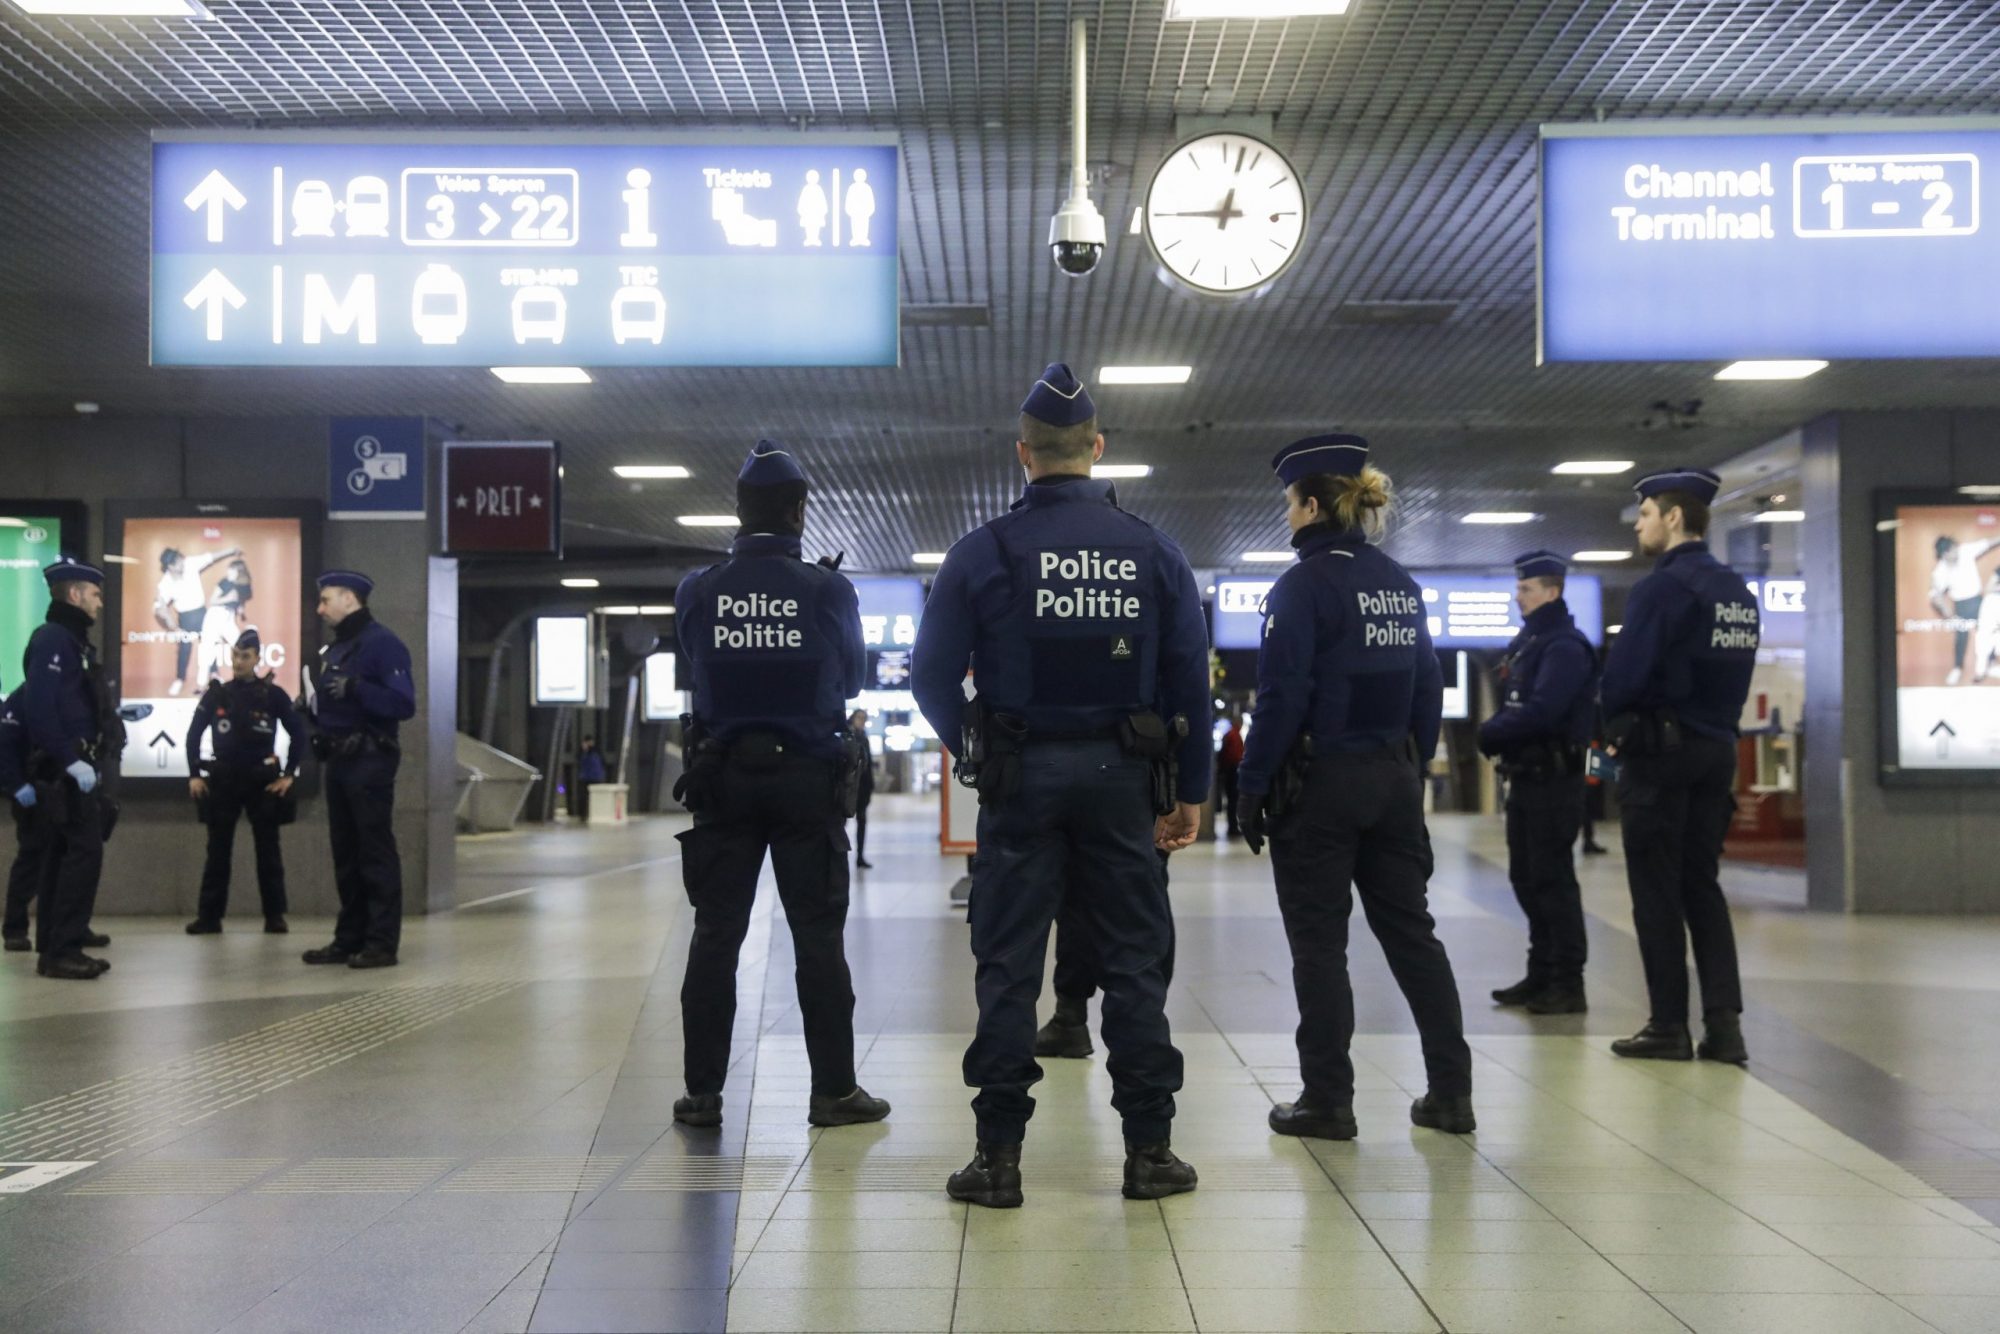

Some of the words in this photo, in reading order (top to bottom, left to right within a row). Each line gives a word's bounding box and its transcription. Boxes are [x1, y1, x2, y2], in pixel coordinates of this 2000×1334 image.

[702, 168, 772, 189] Tickets
[1624, 161, 1775, 199] Channel
[425, 194, 455, 239] 3
[510, 194, 569, 239] 22
[1821, 183, 1844, 231] 1
[1921, 180, 1954, 229] 2
[1611, 204, 1775, 241] Terminal
[618, 266, 659, 286] TEC
[303, 273, 377, 344] M
[475, 486, 524, 517] PRET
[1040, 550, 1137, 580] Police
[717, 592, 798, 618] Police
[1035, 587, 1140, 618] Politie
[1357, 589, 1418, 616] Politie
[1715, 601, 1758, 624] Police
[714, 622, 802, 649] Politie
[1117, 638, 1126, 649] A
[1365, 620, 1417, 647] Police
[1711, 626, 1758, 649] Politie
